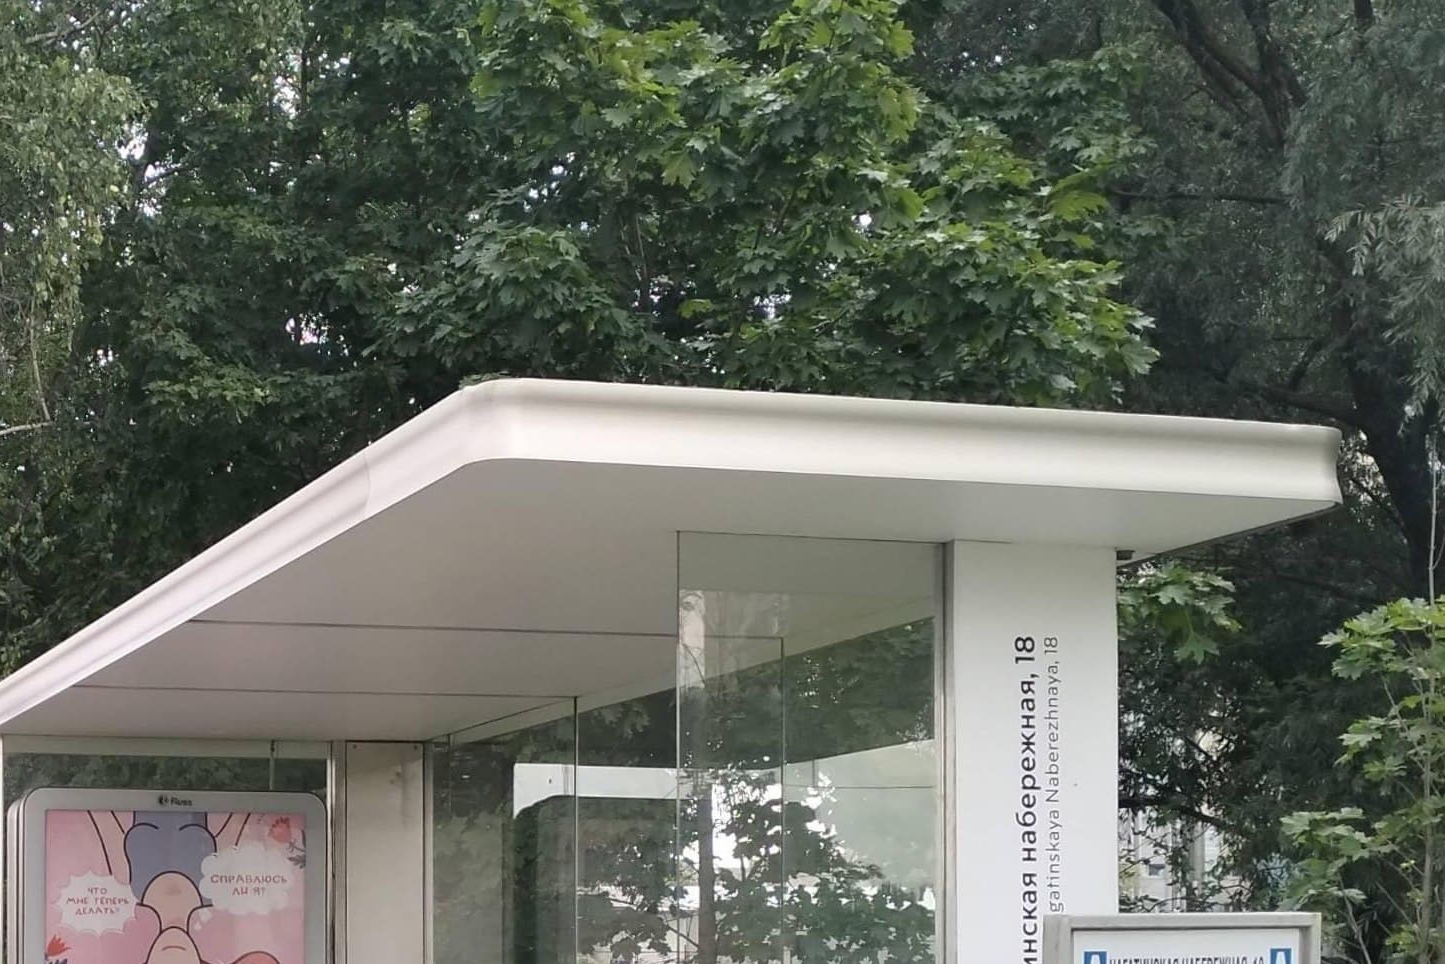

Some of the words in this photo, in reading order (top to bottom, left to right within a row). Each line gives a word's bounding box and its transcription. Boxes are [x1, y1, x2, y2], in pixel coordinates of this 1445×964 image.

[1014, 636, 1036, 665] 18
[1043, 636, 1059, 655] 18
[1044, 660, 1062, 802] Naberezhnaya,
[1015, 673, 1042, 861] набережная,
[1045, 809, 1064, 913] gatinskaya
[210, 873, 288, 884] СПРАВЛЮСЬ
[66, 897, 89, 905] МНЕ
[95, 896, 129, 905] ТЕПЕРЬ
[87, 887, 108, 895] ЧТО
[232, 886, 248, 896] ЛИ
